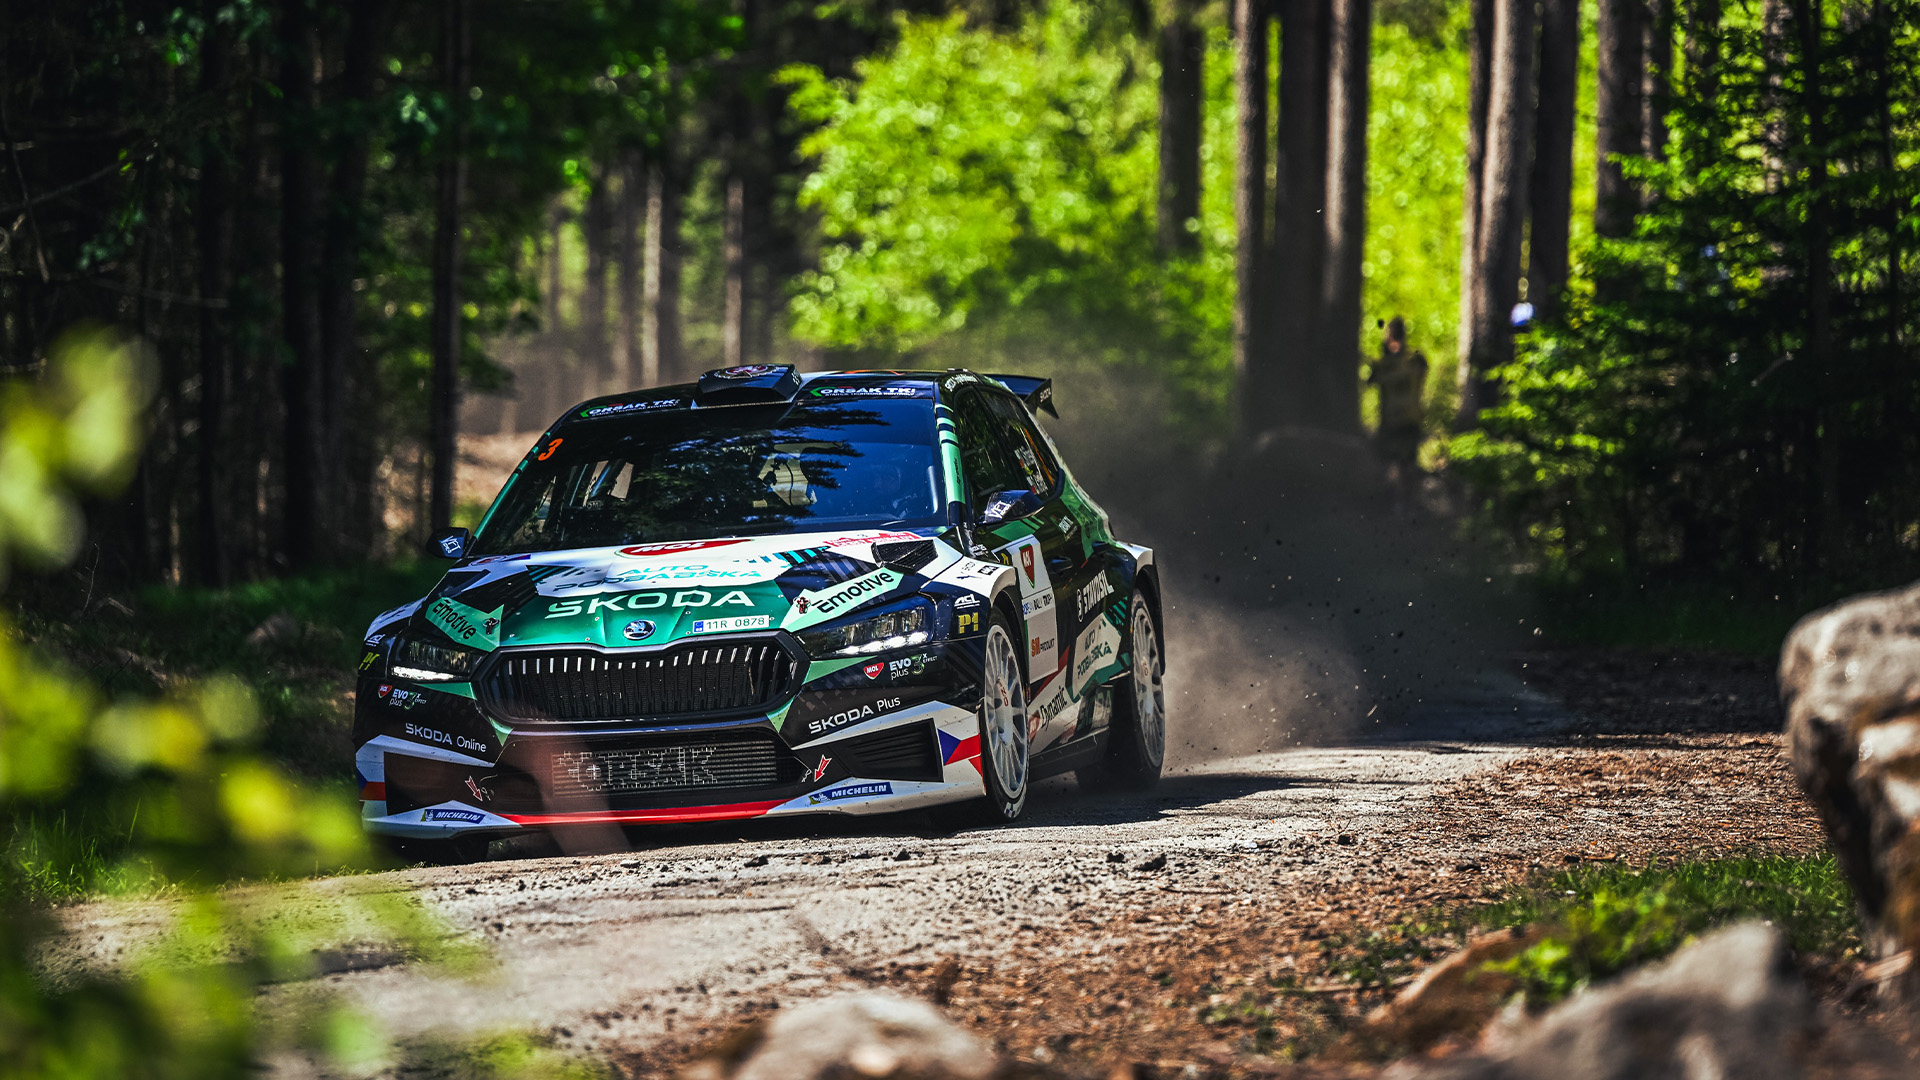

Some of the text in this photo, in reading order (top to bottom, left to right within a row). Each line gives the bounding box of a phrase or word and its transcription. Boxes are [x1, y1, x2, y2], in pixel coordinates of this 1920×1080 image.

[538, 438, 563, 461] 3
[616, 564, 709, 577] AUTO
[706, 616, 765, 629] 11R 0878
[866, 665, 879, 674] MOL
[889, 657, 912, 671] EVO
[890, 669, 909, 681] plus
[392, 688, 409, 700] EVO
[389, 698, 403, 707] plus
[876, 697, 901, 712] Plus
[1040, 685, 1068, 732] Dynamic
[456, 735, 487, 752] Online
[831, 784, 888, 798] MICHELIN
[435, 811, 482, 821] MICHELIN
